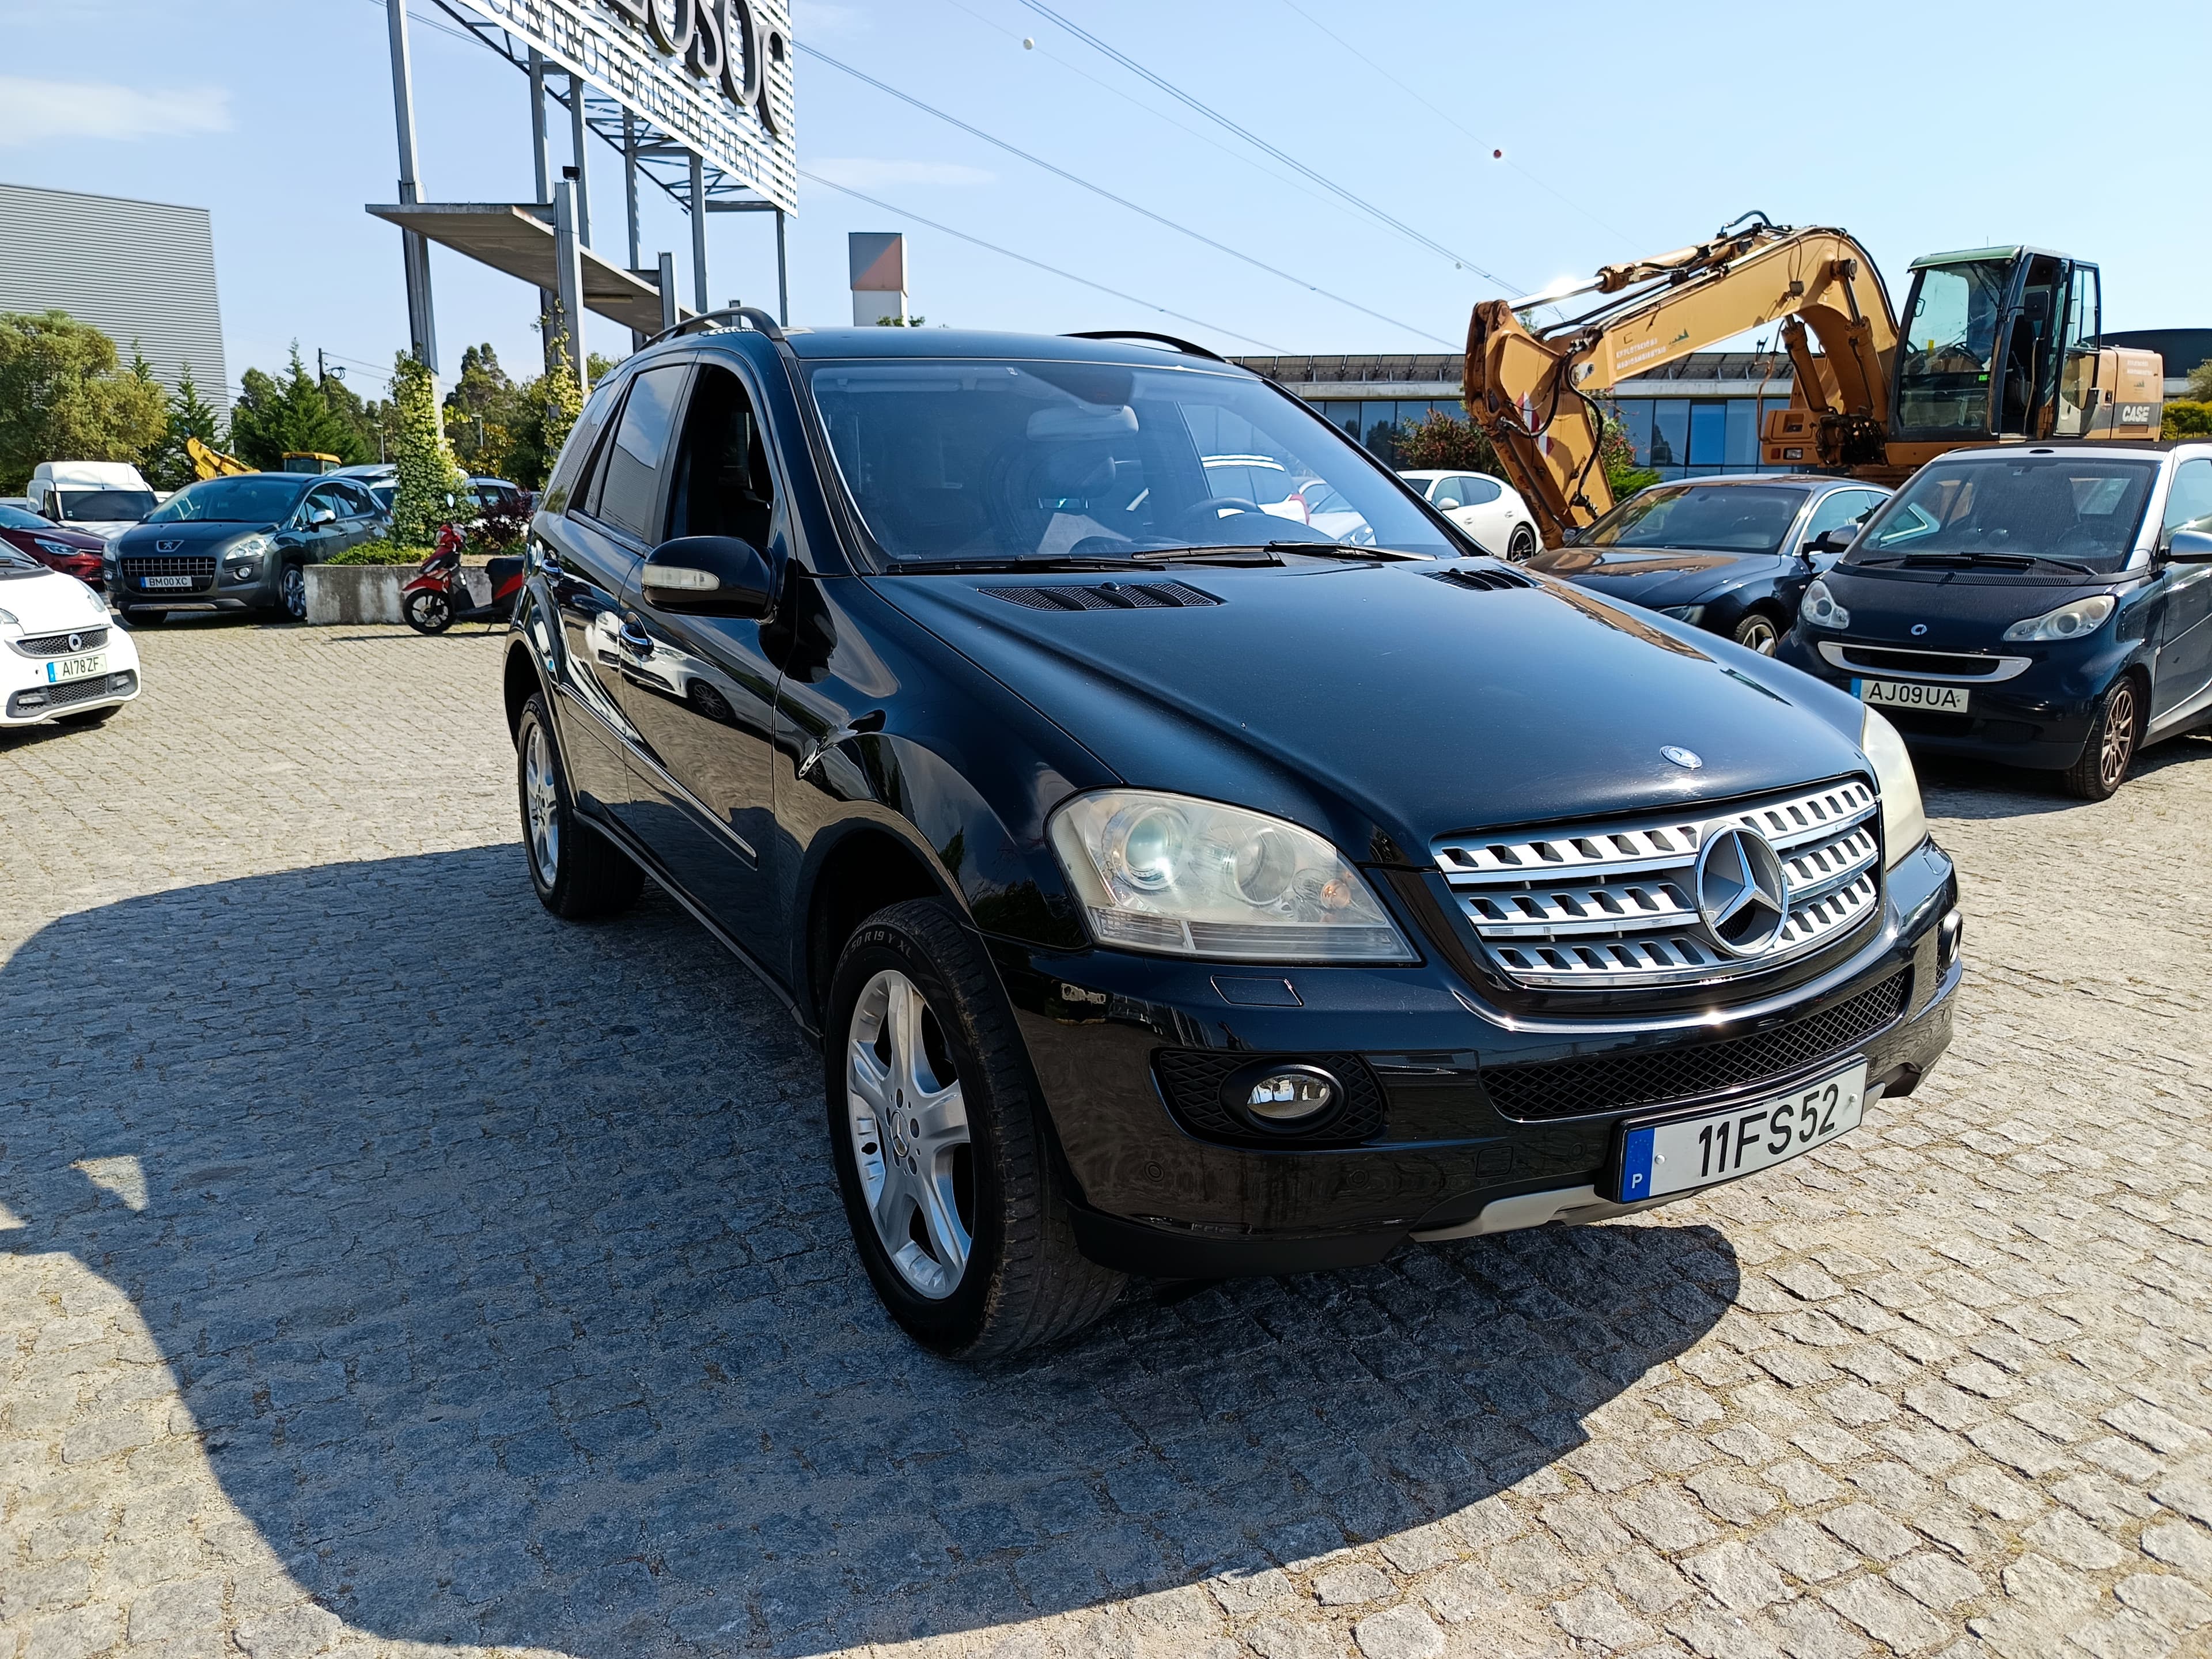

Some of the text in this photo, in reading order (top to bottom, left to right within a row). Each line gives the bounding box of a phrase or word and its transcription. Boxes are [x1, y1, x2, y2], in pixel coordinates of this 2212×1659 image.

[2122, 406, 2150, 422] CASE
[1869, 683, 1957, 707] AJ09UA
[1631, 1084, 1839, 1188] P 11FS52
